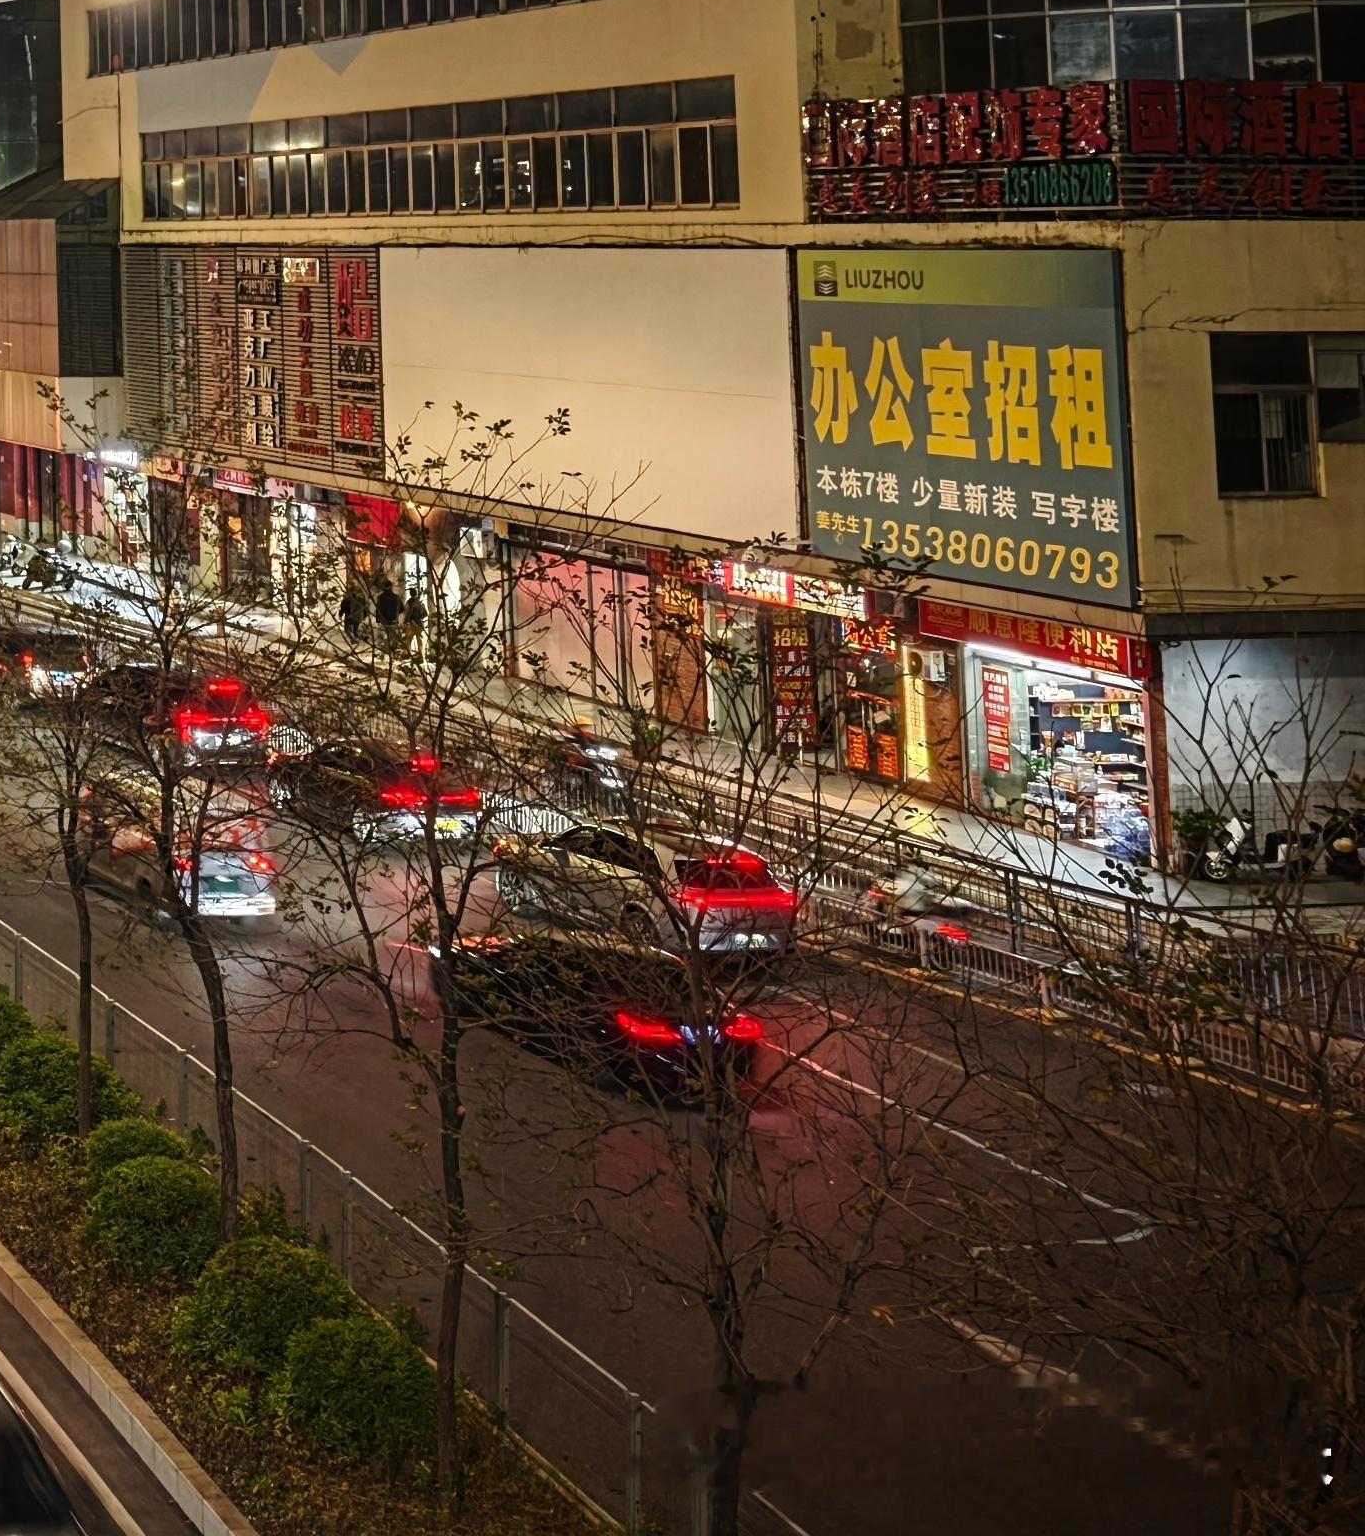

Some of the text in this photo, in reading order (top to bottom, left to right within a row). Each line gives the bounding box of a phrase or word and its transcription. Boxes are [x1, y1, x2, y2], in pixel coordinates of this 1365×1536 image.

[1003, 165, 1114, 206] 13510866208
[845, 268, 925, 291] LIUZHOU
[810, 331, 1113, 470] 办公室招租
[816, 465, 1119, 534] 本栋7楼 少量新装 写字楼
[816, 510, 1119, 590] 姜先生 13538060793
